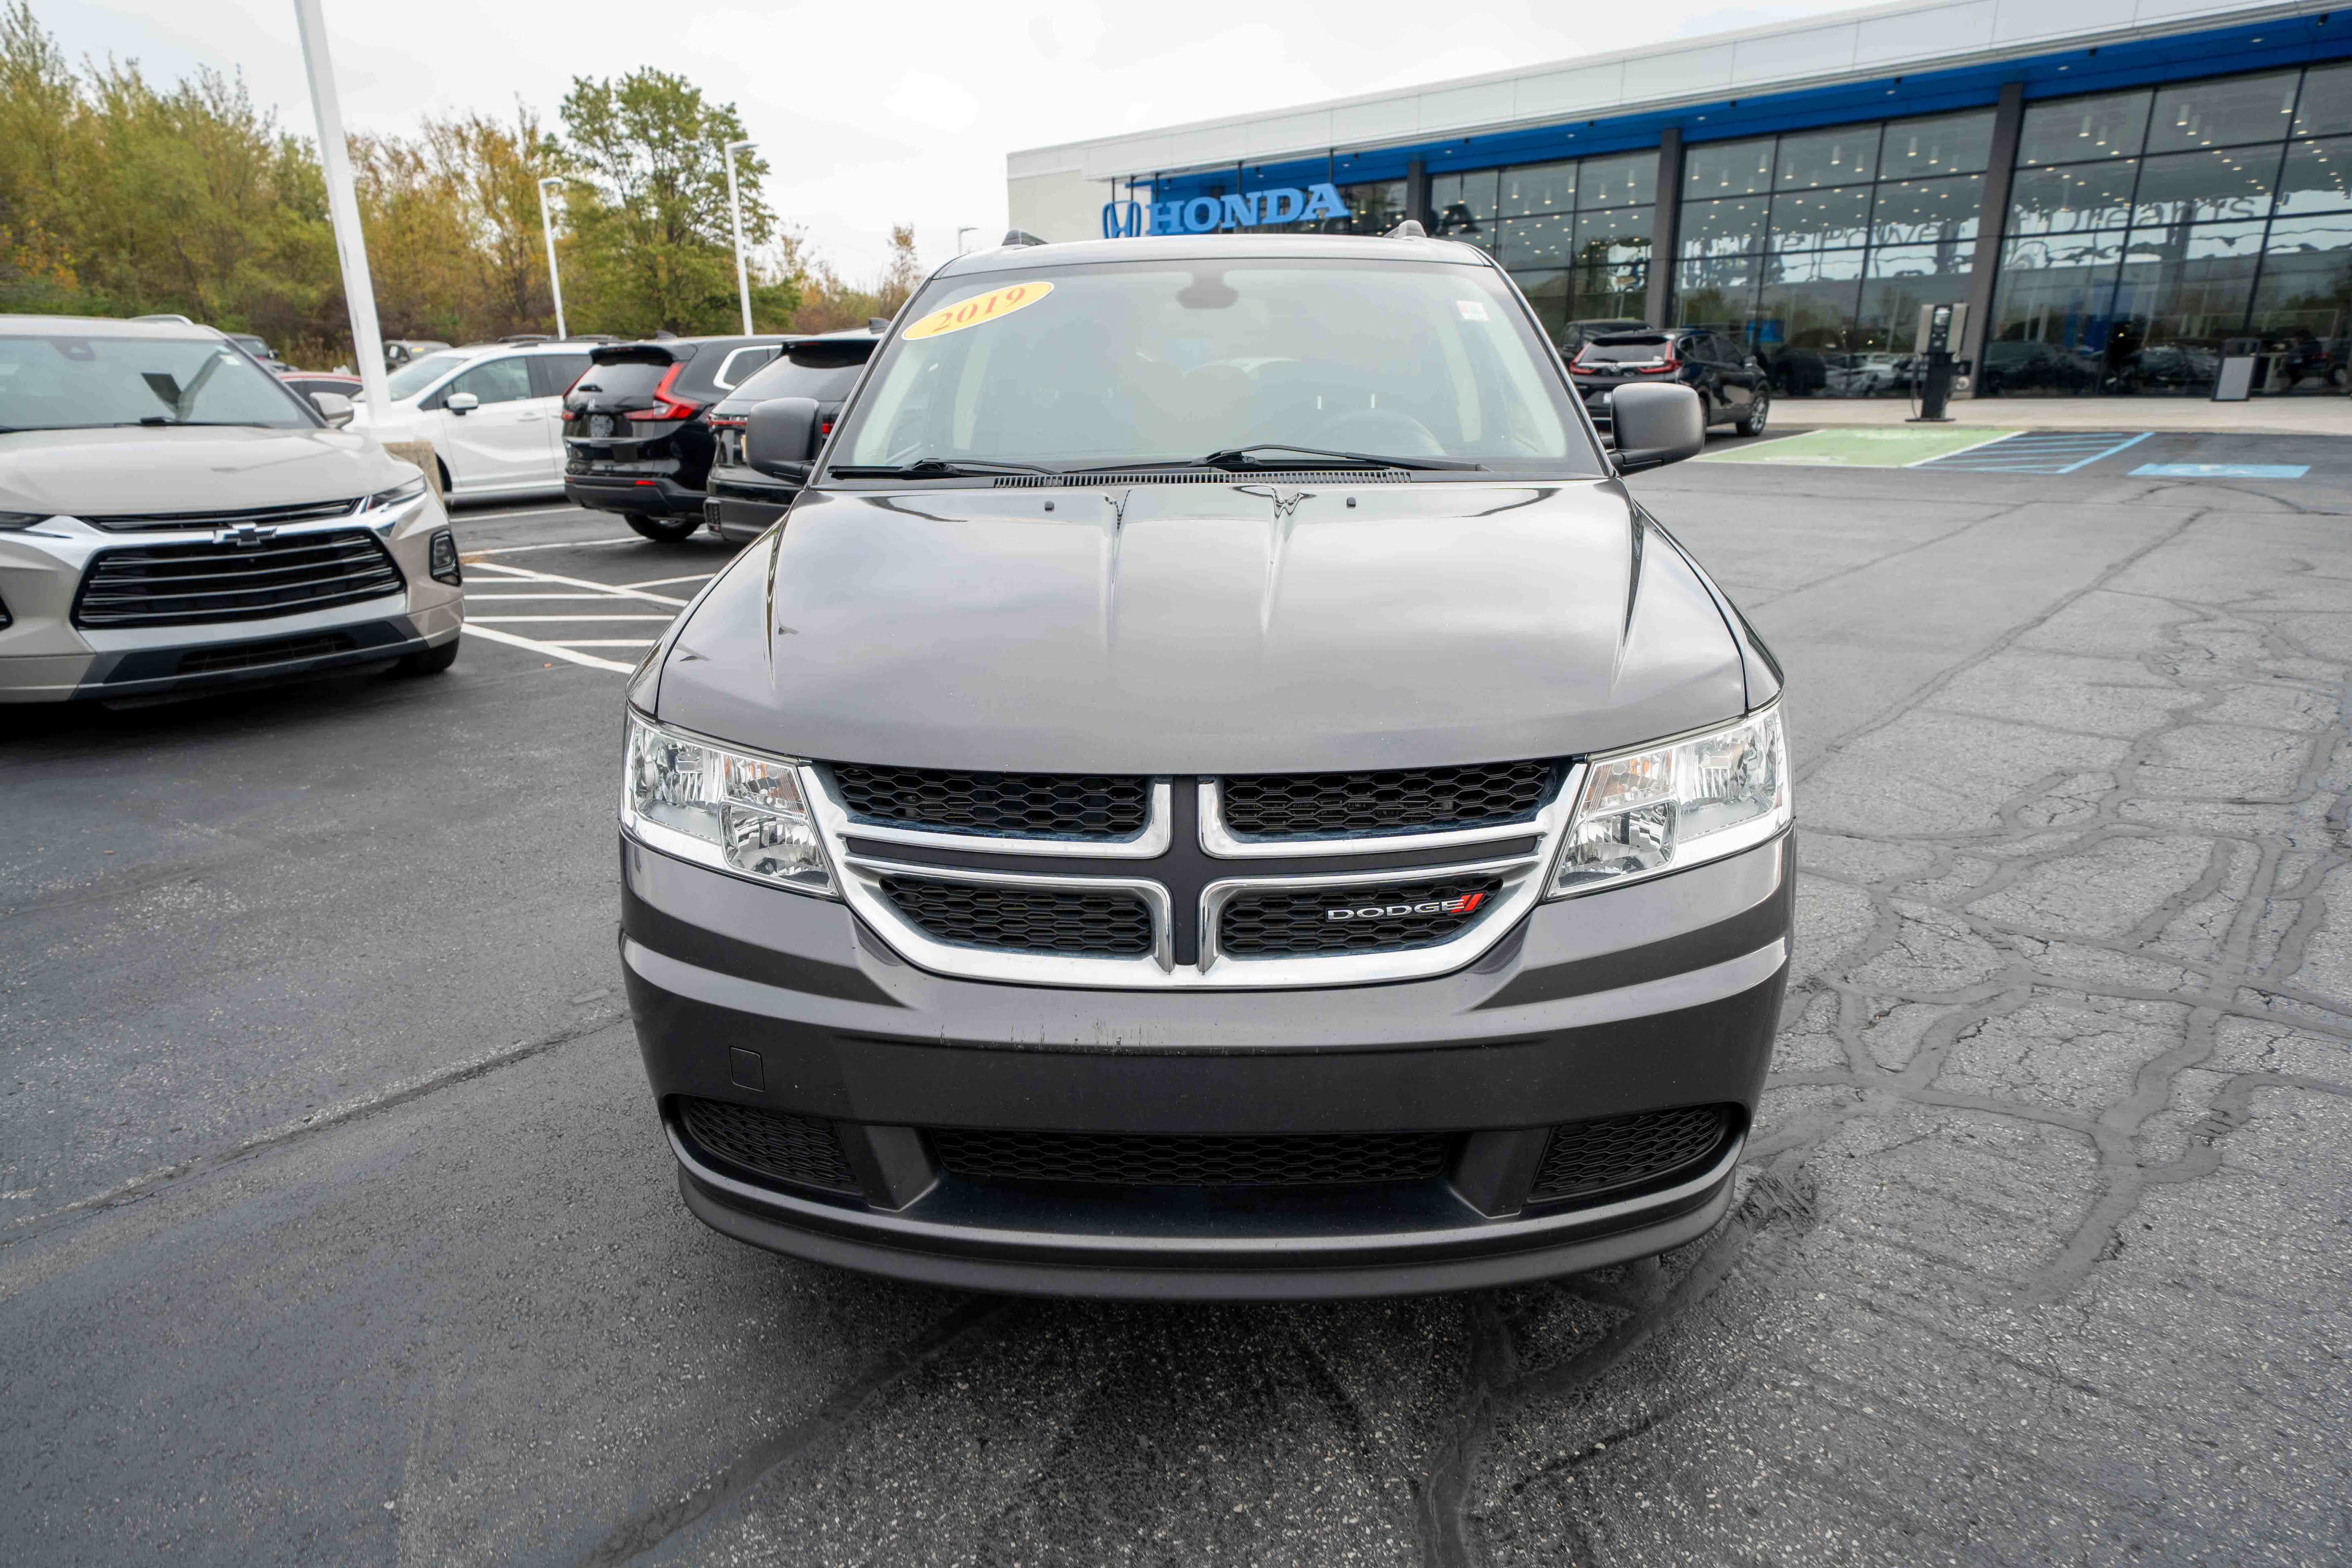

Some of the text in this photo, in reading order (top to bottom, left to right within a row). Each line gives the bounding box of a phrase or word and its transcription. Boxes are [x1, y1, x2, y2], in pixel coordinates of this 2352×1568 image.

[1146, 183, 1351, 236] HONDA
[932, 287, 1025, 333] 2019
[1328, 899, 1464, 920] DODGE
